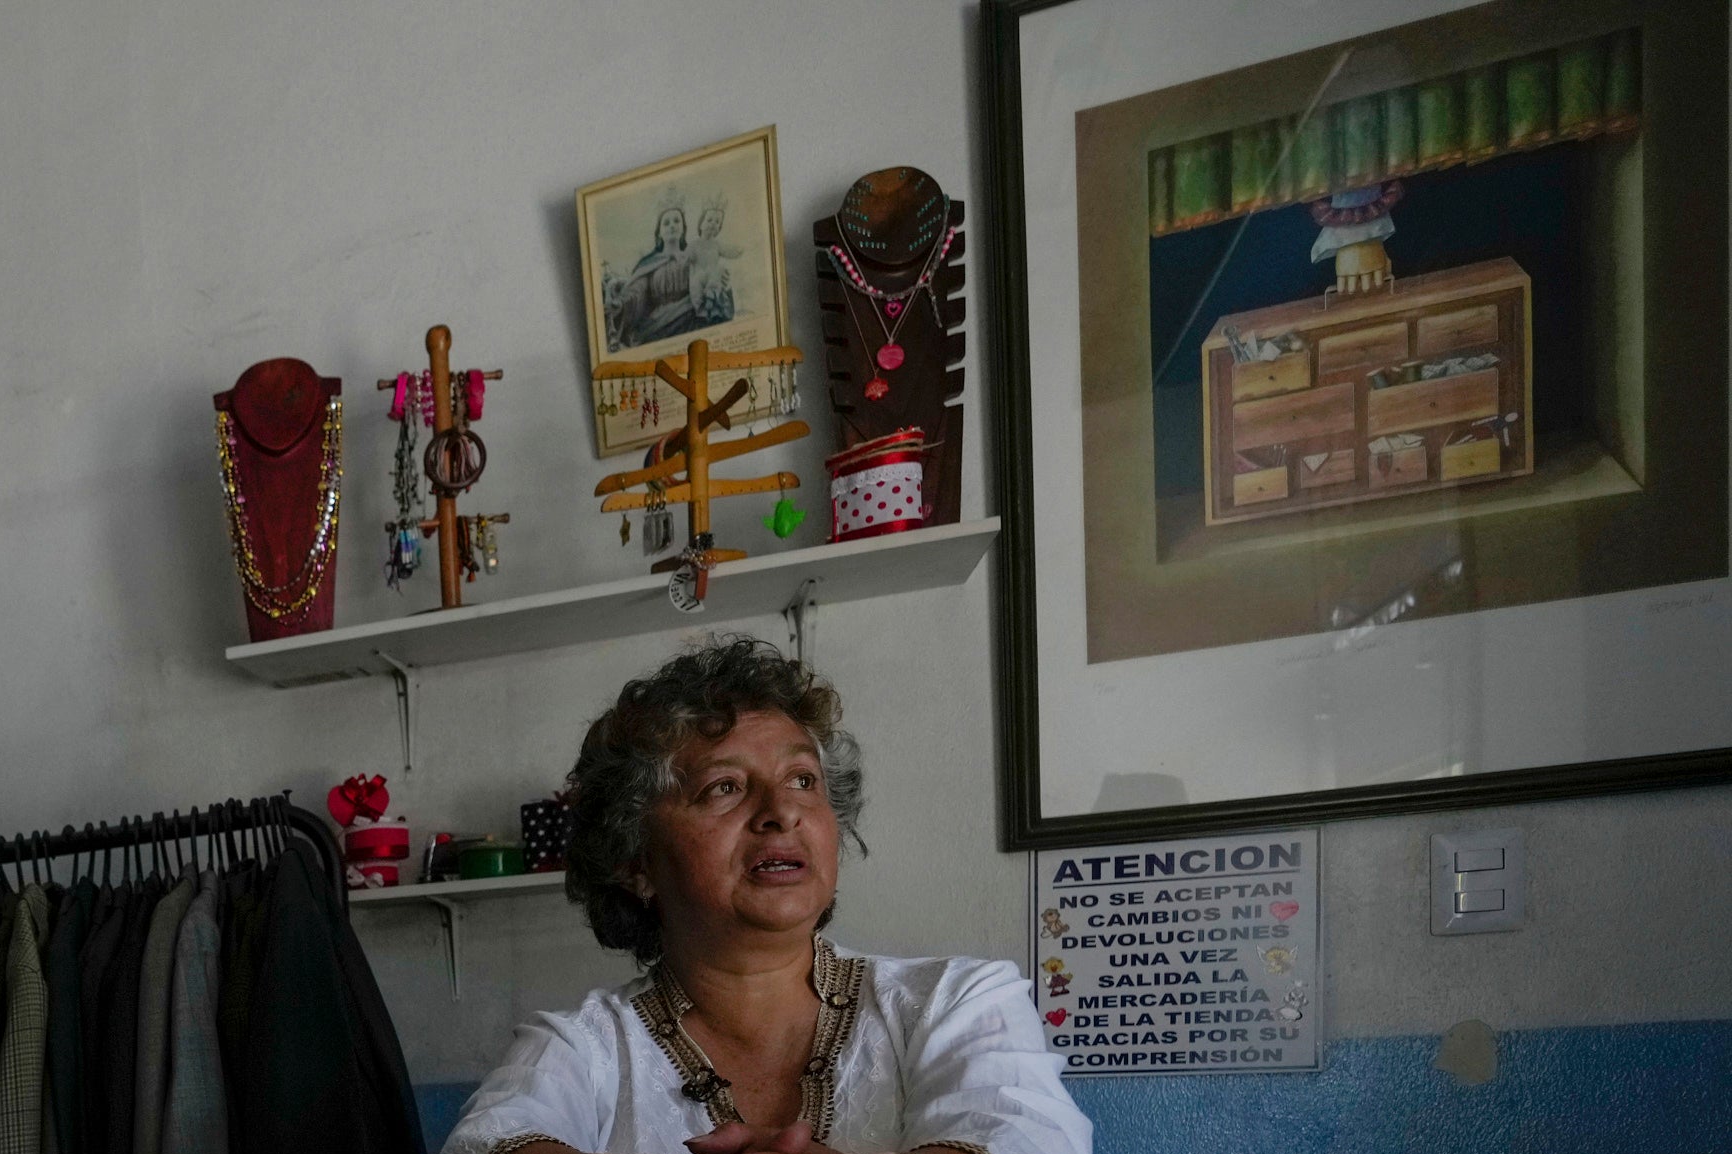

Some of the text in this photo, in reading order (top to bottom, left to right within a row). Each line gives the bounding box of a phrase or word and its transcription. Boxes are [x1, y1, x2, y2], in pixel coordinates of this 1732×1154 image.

[1053, 842, 1300, 882] ATENCION
[1059, 881, 1291, 909] NO SE ACEPTAN
[1088, 905, 1260, 927] CAMBIOS NI
[1062, 924, 1288, 949] DEVOLUCIONES
[1110, 949, 1236, 967] UNA VEZ
[1099, 969, 1248, 987] SALIDA LA
[1078, 986, 1269, 1009] MERCADERÍA
[1074, 1007, 1272, 1028] DE LA TIENDA
[1052, 1027, 1298, 1047] GRACIAS POR SU
[1068, 1046, 1281, 1067] COMPRENSIÓN
